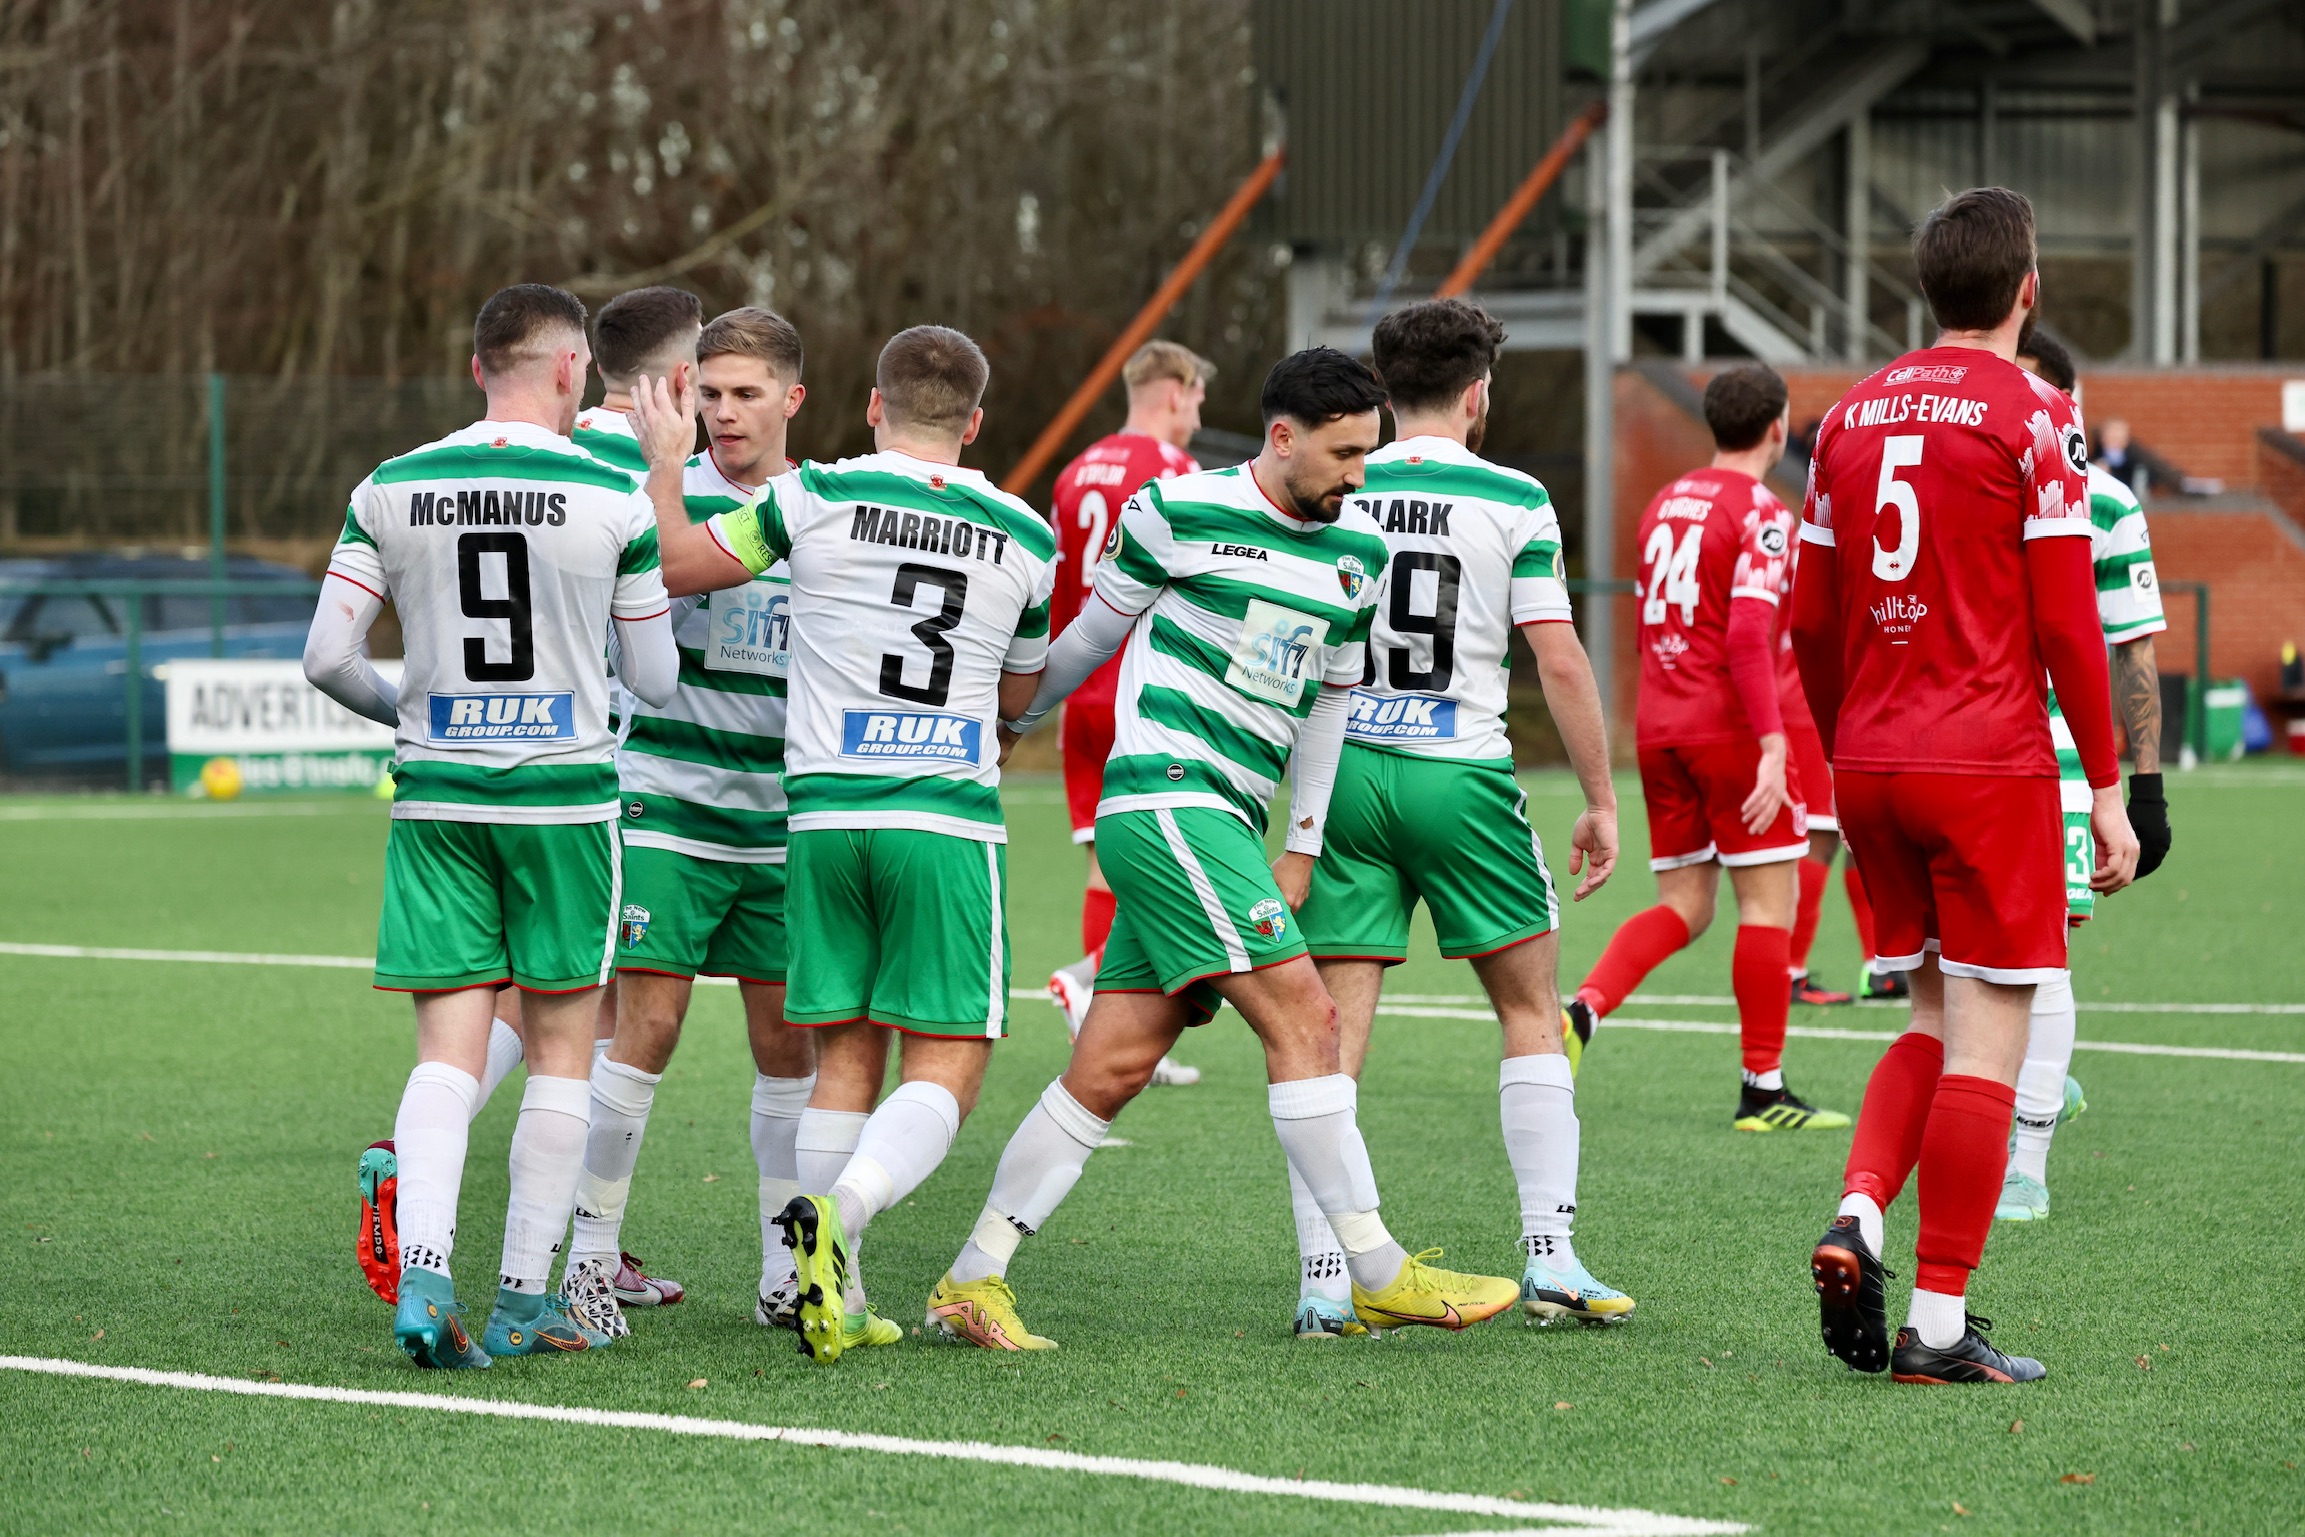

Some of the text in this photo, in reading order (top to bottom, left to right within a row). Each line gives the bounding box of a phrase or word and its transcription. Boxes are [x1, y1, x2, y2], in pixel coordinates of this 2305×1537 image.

[1886, 367, 1950, 382] CellPath
[1844, 394, 1988, 430] K MILLS-EVANS
[2071, 441, 2087, 462] JD
[410, 490, 567, 527] McMANUS
[1872, 435, 1925, 581] 5
[850, 505, 1008, 565] MARRIOTT
[1211, 543, 1268, 561] LEGEA
[1643, 523, 1705, 627] 24
[458, 532, 534, 682] 9
[1870, 596, 1928, 625] hilltop
[879, 563, 968, 707] 3
[720, 645, 786, 666] Networks
[1242, 666, 1296, 694] Networks
[450, 697, 556, 725] RUK
[1350, 699, 1441, 726] RUK
[444, 725, 559, 737] GROUP.COM
[863, 714, 969, 746] RUK
[856, 742, 969, 759] GROUP.COM
[373, 1203, 383, 1254] TIEMPO
